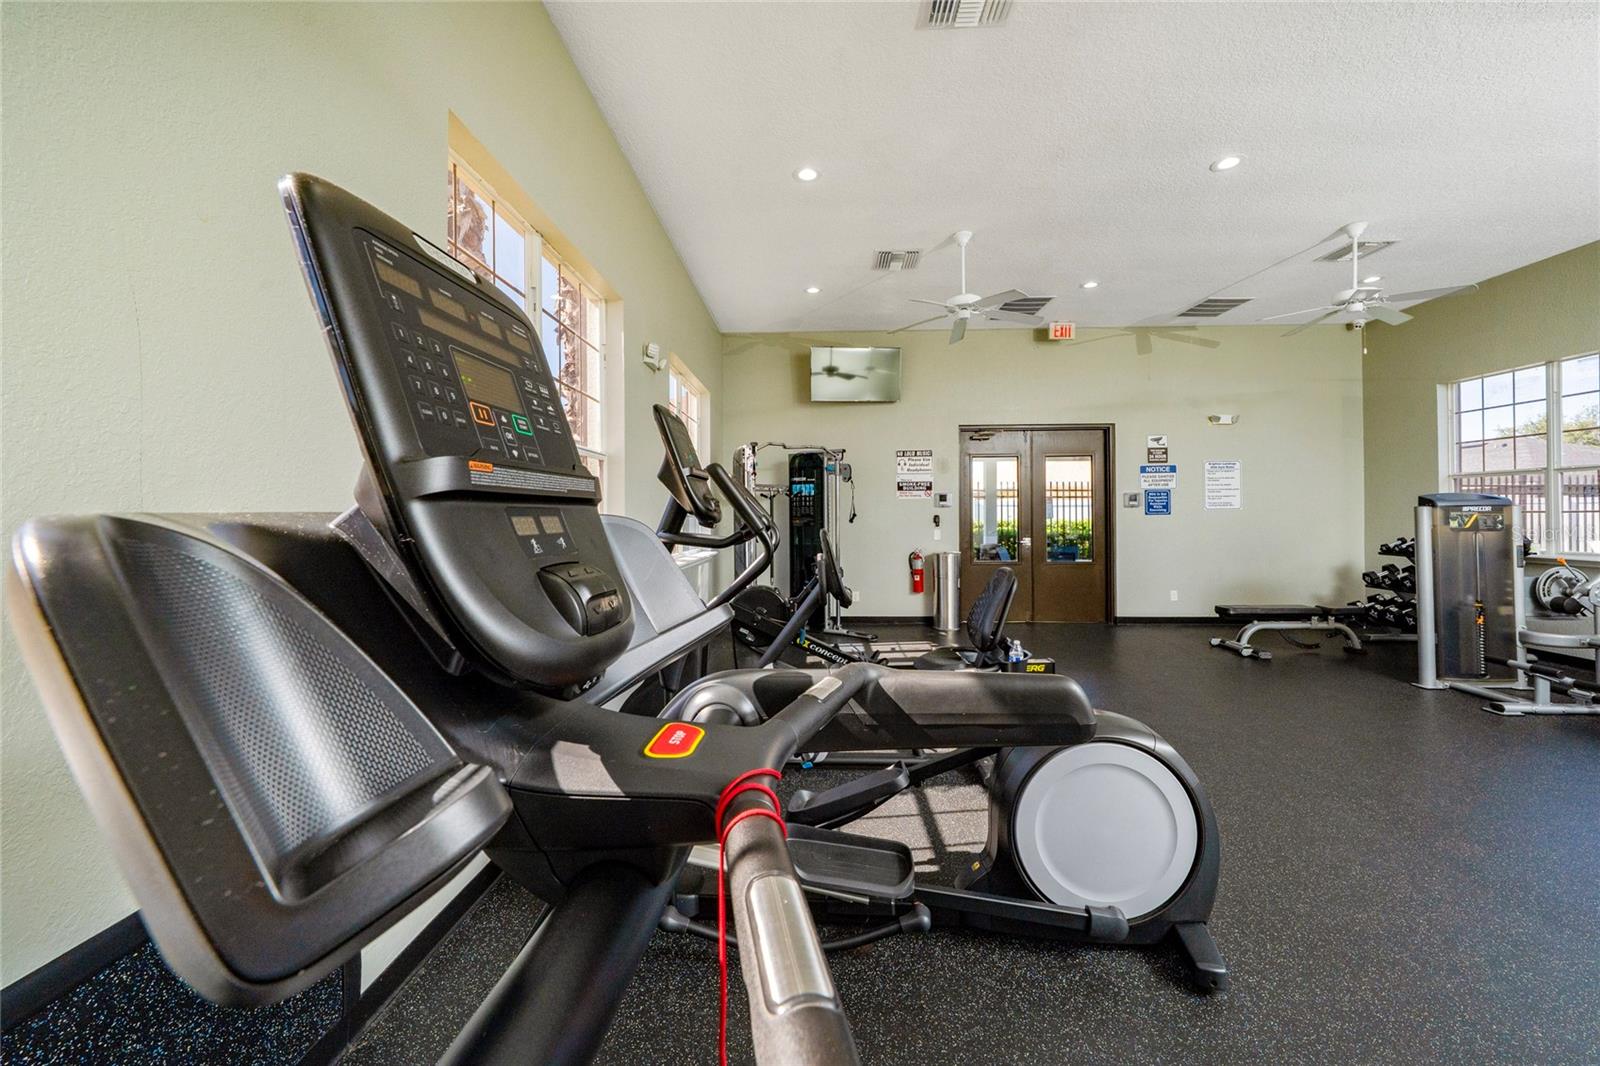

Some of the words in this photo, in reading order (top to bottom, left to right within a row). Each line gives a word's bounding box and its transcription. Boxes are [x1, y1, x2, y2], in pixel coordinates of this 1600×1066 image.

[1053, 323, 1072, 338] EXIT
[505, 432, 514, 441] OK
[809, 643, 849, 665] concept
[1025, 664, 1046, 672] ERG
[668, 730, 686, 744] STOP
